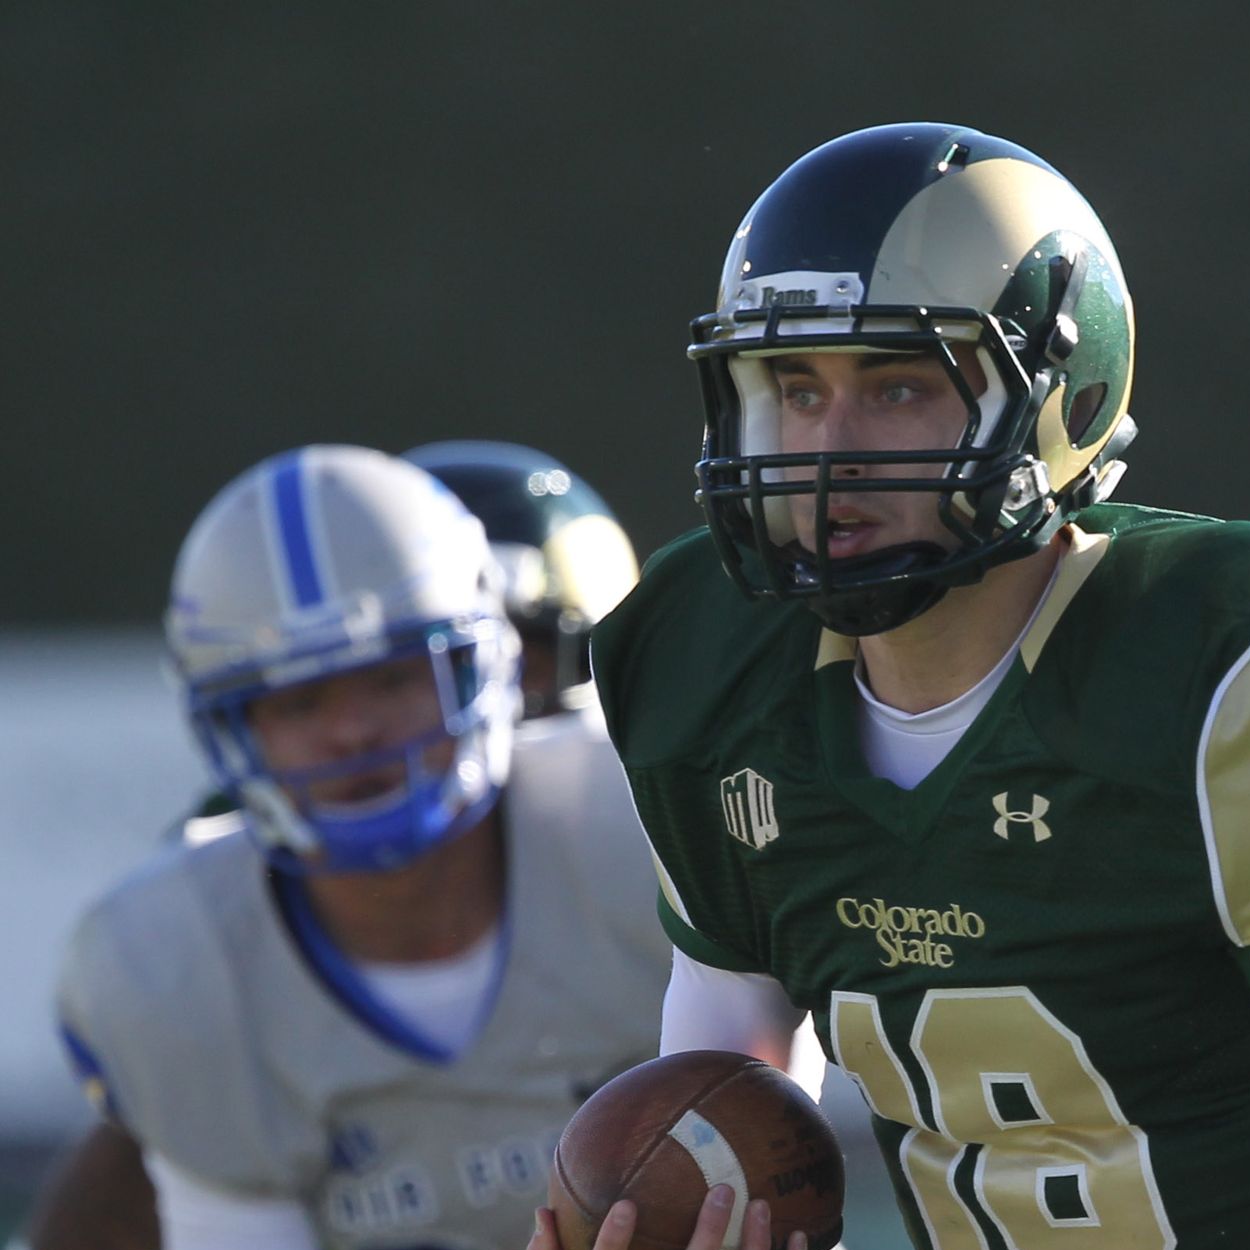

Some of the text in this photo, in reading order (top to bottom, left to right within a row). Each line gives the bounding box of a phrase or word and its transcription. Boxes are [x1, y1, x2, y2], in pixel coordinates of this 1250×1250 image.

[762, 286, 817, 307] Rams
[836, 897, 986, 939] Colorado
[875, 926, 955, 968] State
